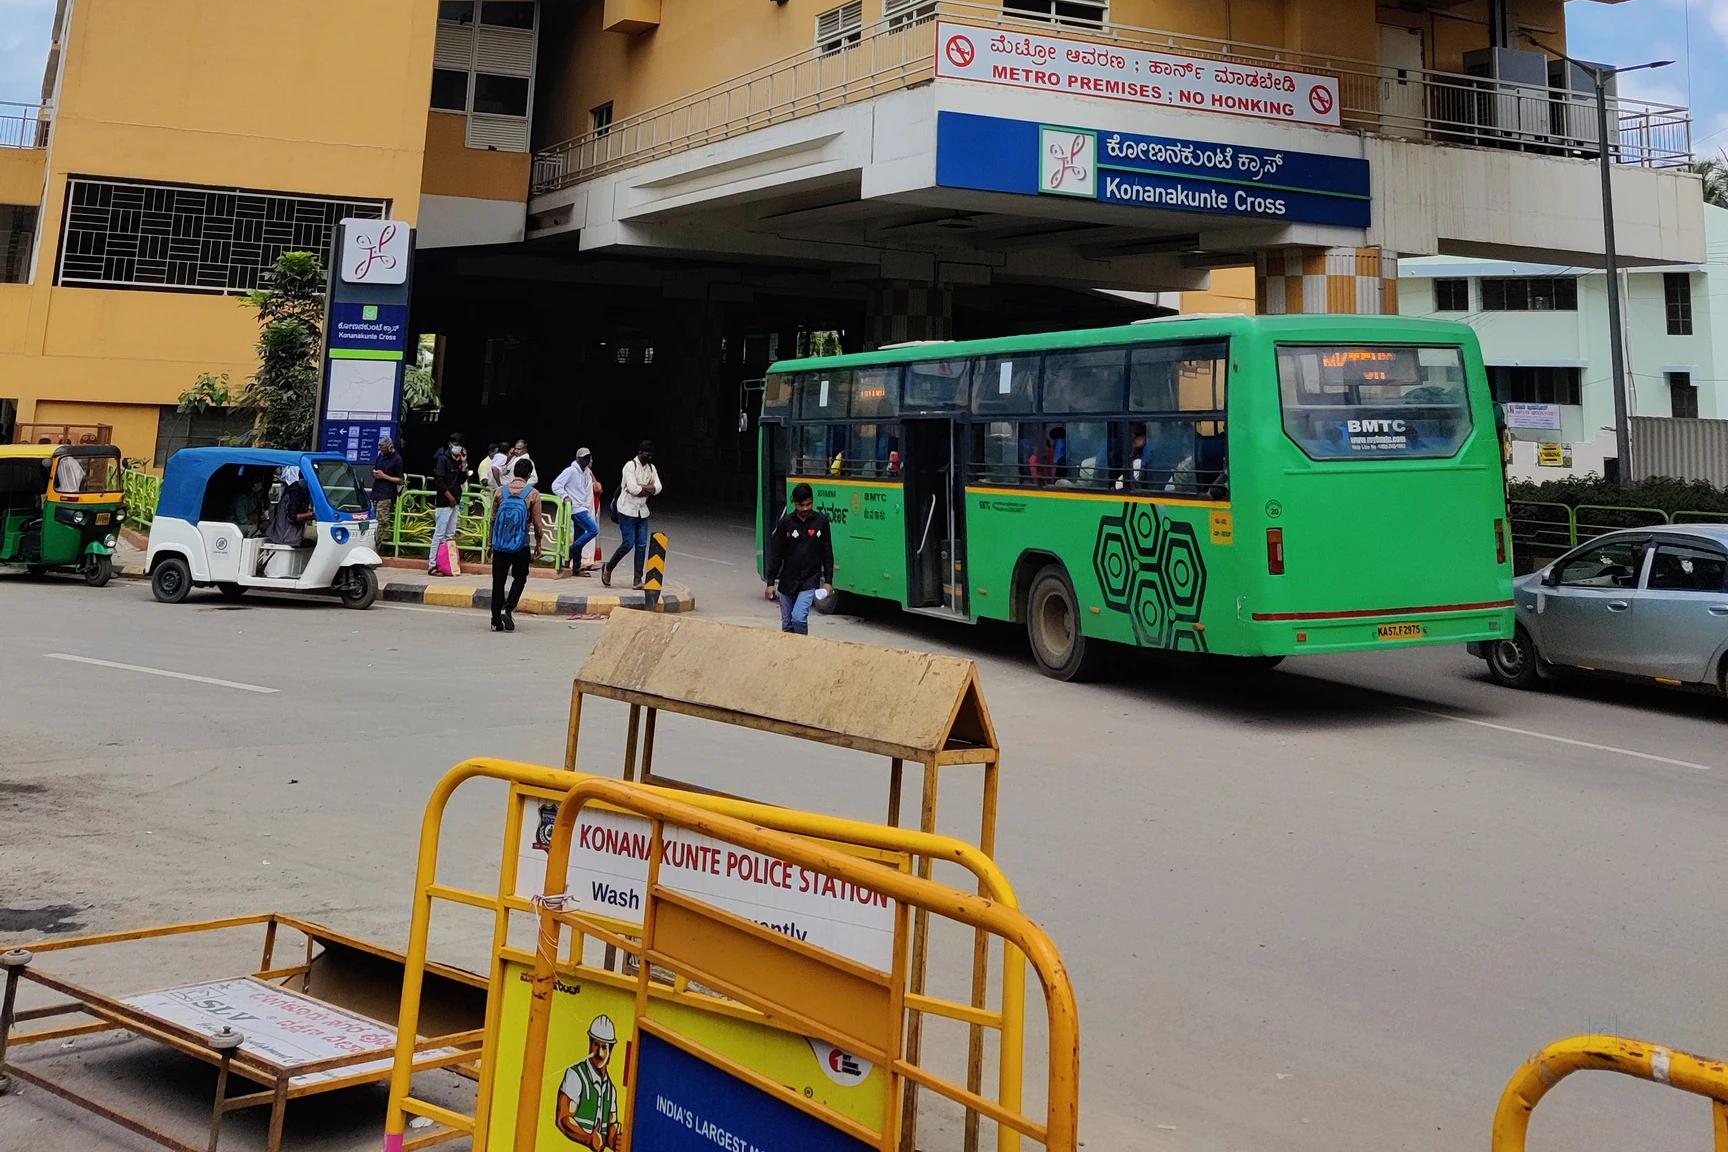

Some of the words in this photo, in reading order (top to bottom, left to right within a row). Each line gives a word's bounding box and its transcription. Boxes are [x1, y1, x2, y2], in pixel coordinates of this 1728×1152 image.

[990, 34, 1057, 66] ಮೆಟ್ರೋ
[1066, 47, 1126, 70] ಆವರಣ
[1213, 66, 1296, 93] ಮಾಡಬೇಡಿ
[992, 64, 1061, 86] METRO
[1067, 74, 1162, 99] PREMISES
[1179, 89, 1205, 105] NO
[1211, 93, 1295, 117] HONKING
[1106, 133, 1233, 169] ಕೋಣನಕುಂಟೆ
[1237, 152, 1284, 181] ಕ್ರಾಸ್
[1106, 176, 1228, 209] Konanakunte
[1234, 190, 1286, 215] Cross
[338, 331, 378, 340] Konanakunte
[378, 333, 397, 341] Cross
[1347, 419, 1406, 433] BMTC
[864, 492, 887, 503] BMTC
[1270, 508, 1279, 516] 20
[726, 851, 794, 890] POLICE
[591, 880, 640, 911] Wash
[191, 999, 260, 1021] SLV
[656, 1094, 693, 1129] INDIA'S
[695, 1115, 748, 1152] LARGEST
